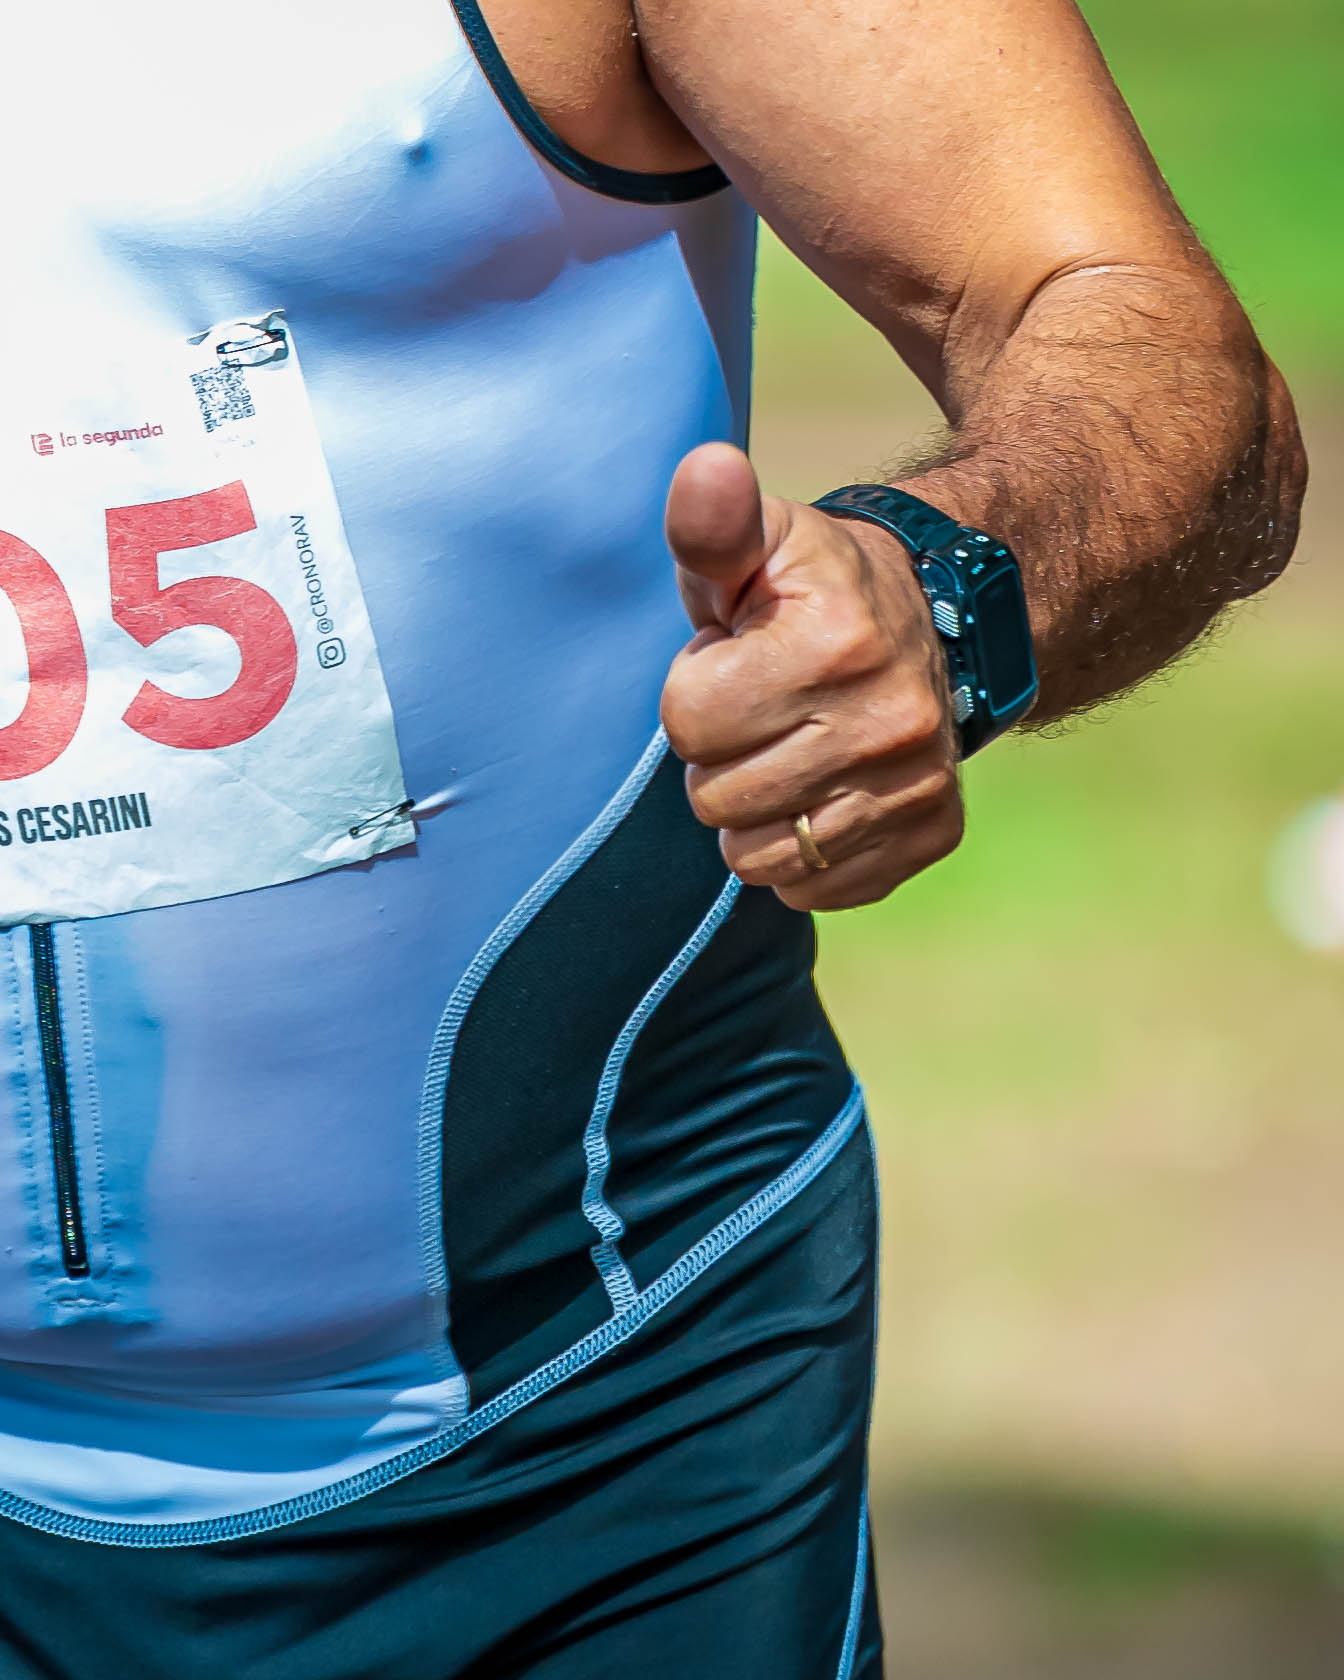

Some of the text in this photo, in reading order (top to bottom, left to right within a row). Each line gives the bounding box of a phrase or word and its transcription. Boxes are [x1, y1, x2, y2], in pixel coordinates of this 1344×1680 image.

[59, 422, 164, 448] la segunda
[289, 514, 334, 635] @CRONORAV
[16, 792, 153, 844] CESARINI
